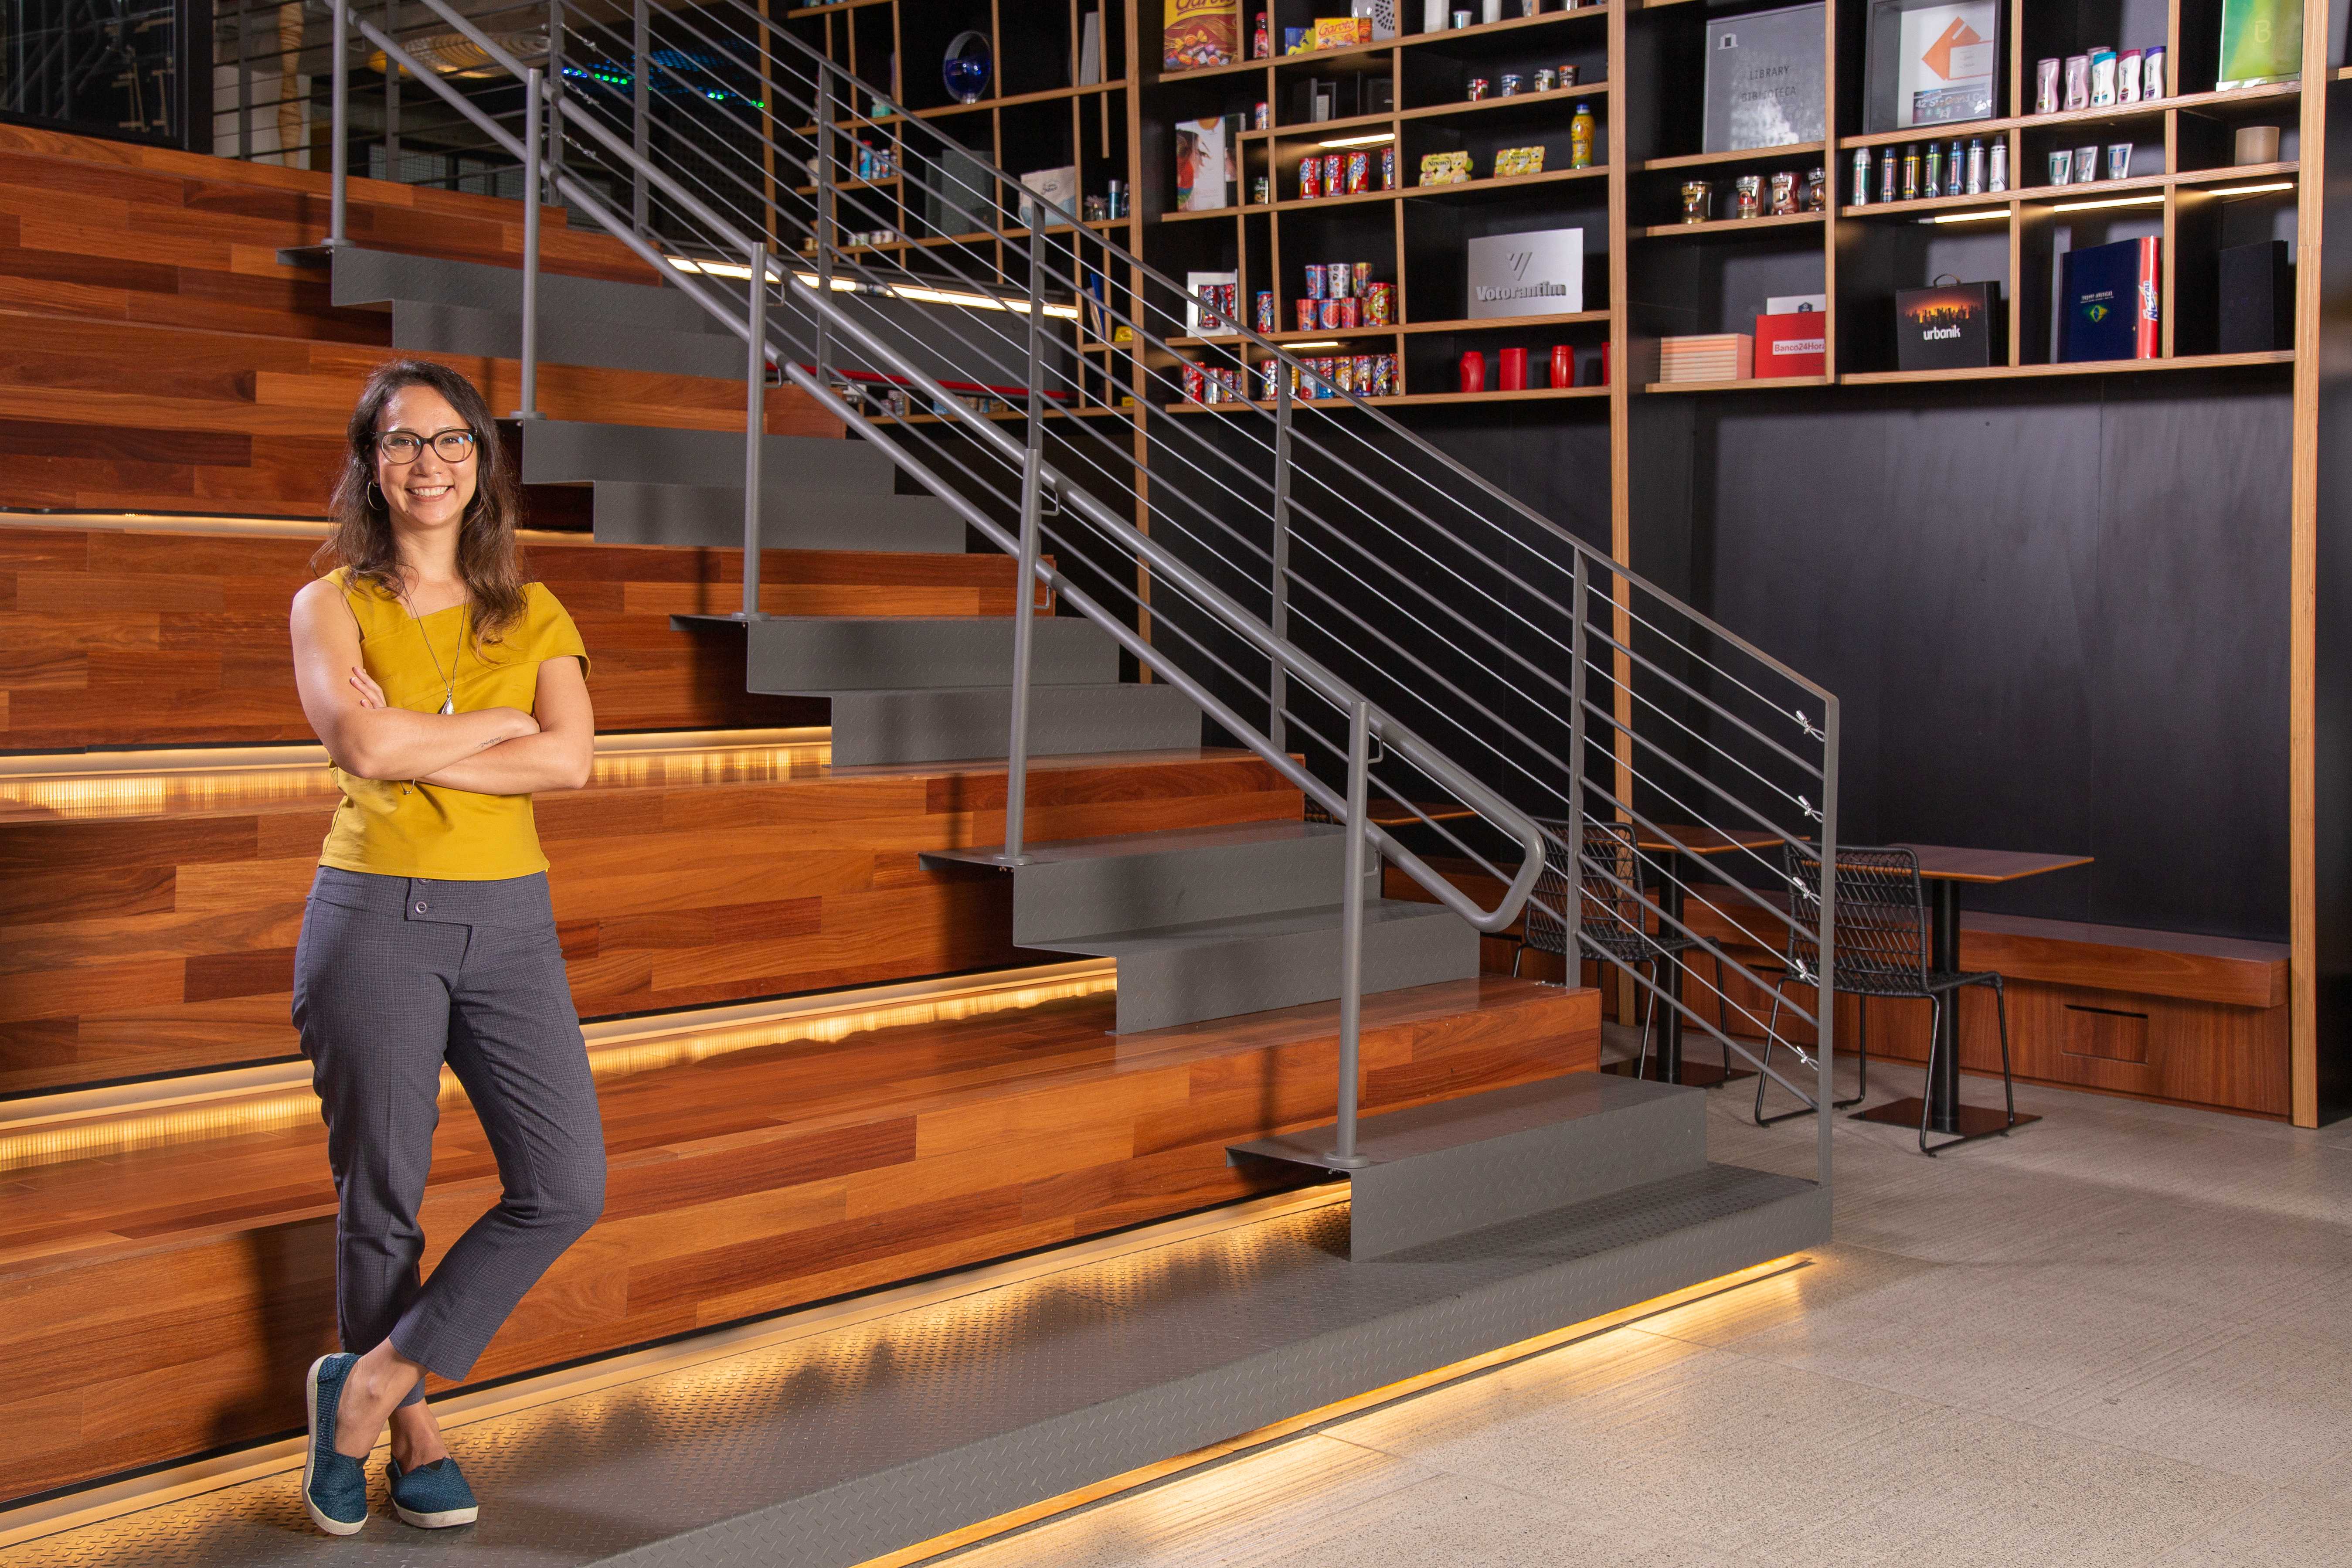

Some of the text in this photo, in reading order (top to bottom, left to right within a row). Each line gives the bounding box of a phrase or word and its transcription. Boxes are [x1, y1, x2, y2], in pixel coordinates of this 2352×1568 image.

[1319, 20, 1355, 36] Garoto
[1749, 66, 1790, 80] LIBRARY
[1476, 281, 1566, 302] Votorantim
[1923, 324, 1961, 340] urbanik
